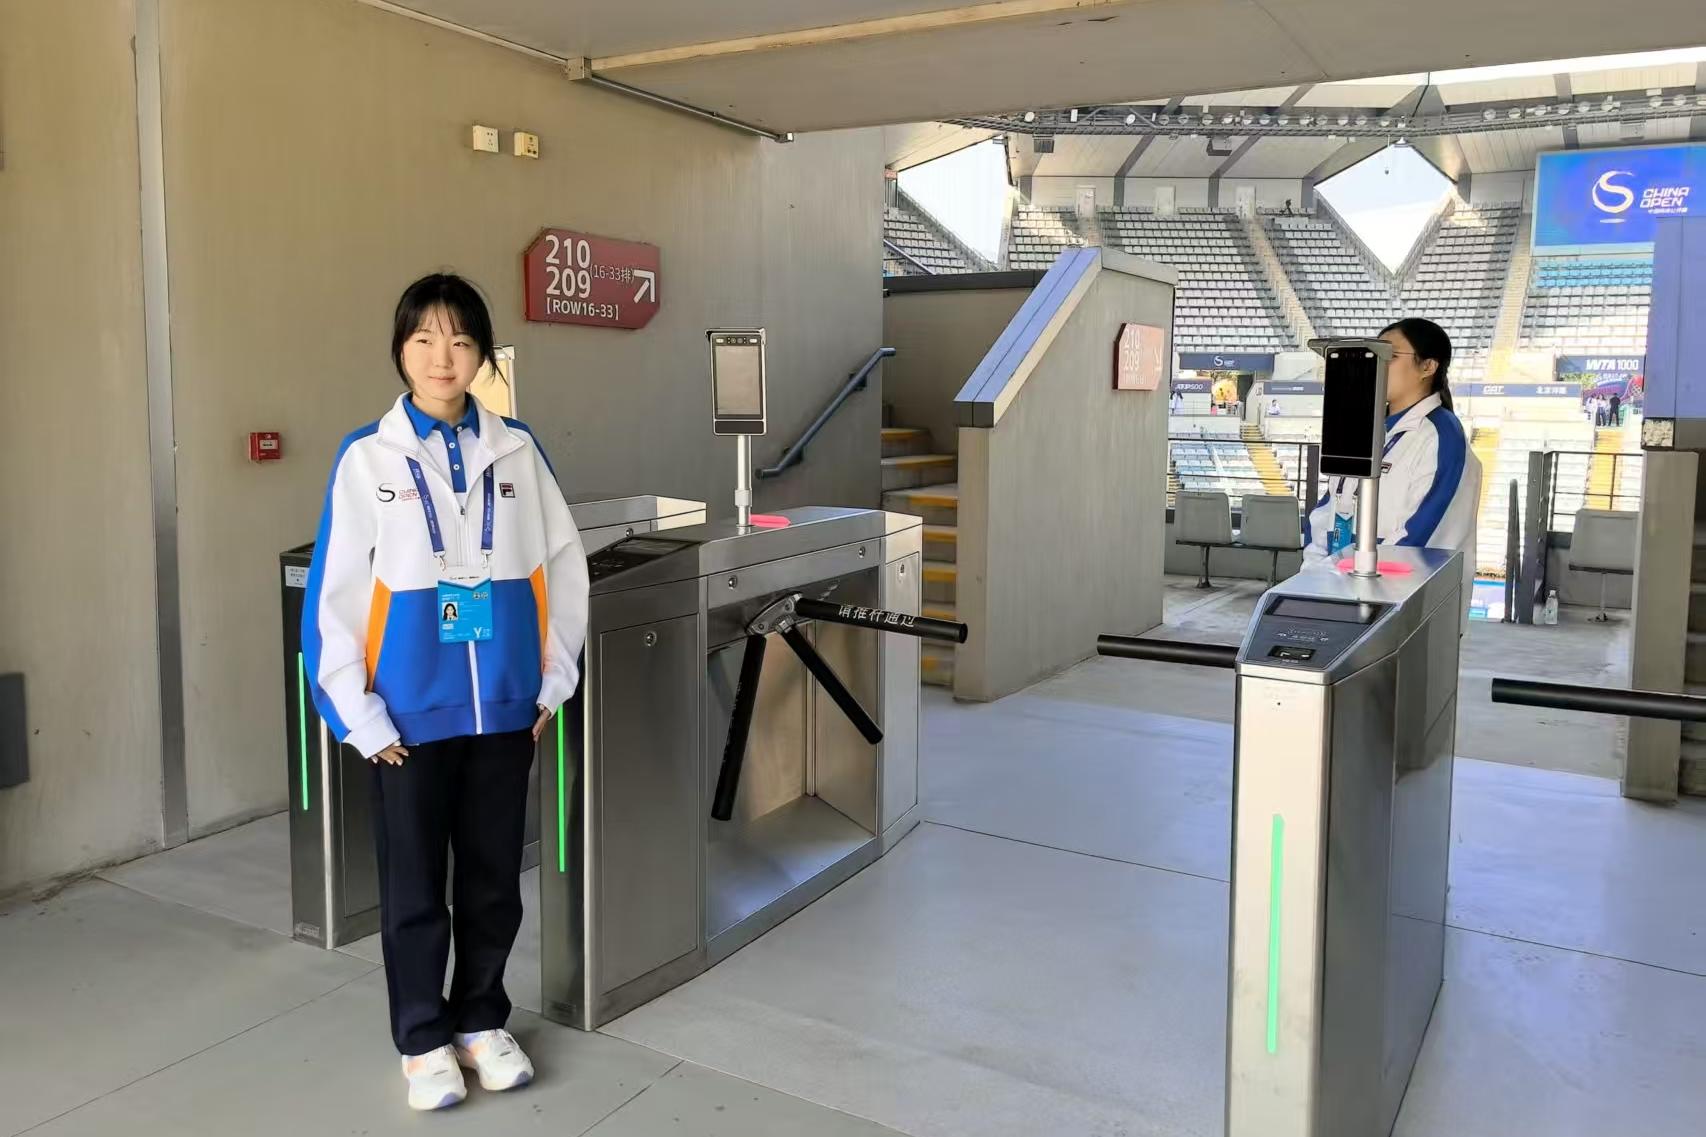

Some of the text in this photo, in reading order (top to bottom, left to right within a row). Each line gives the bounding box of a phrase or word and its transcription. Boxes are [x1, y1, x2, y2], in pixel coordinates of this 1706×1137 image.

[1643, 186, 1690, 199] CHINA
[1640, 197, 1684, 209] OPEN
[545, 234, 591, 269] 210
[546, 265, 592, 299] 209
[1124, 328, 1141, 350] 210
[1124, 349, 1141, 371] 209
[1585, 359, 1639, 371] WTA 1000
[473, 626, 483, 639] Y
